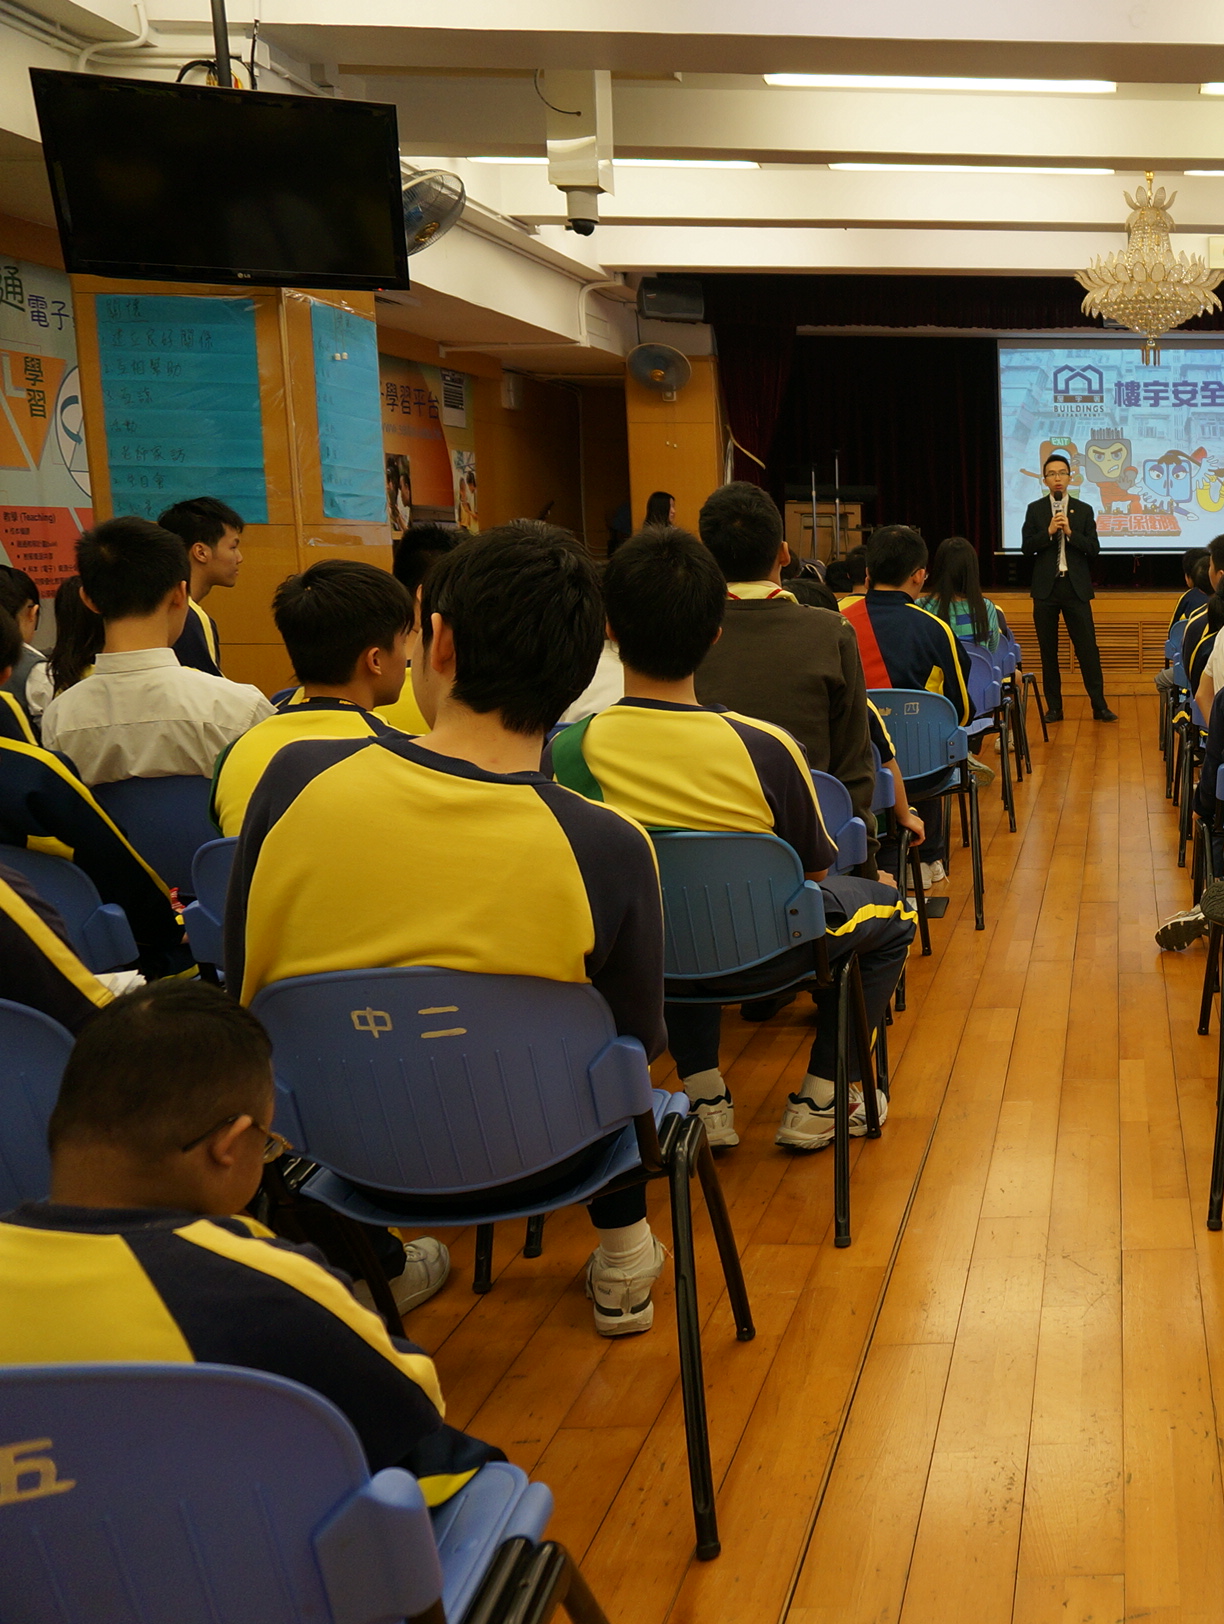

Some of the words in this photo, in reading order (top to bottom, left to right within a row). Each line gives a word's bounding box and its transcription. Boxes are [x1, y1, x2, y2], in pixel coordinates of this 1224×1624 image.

[28, 294, 75, 331] 電子
[23, 356, 47, 419] 學習
[380, 381, 440, 419] 學習平台
[1053, 404, 1104, 413] BUILDINGS
[1051, 437, 1069, 446] EXIT
[20, 511, 57, 524] (Teaching)
[349, 1005, 469, 1040] 中二
